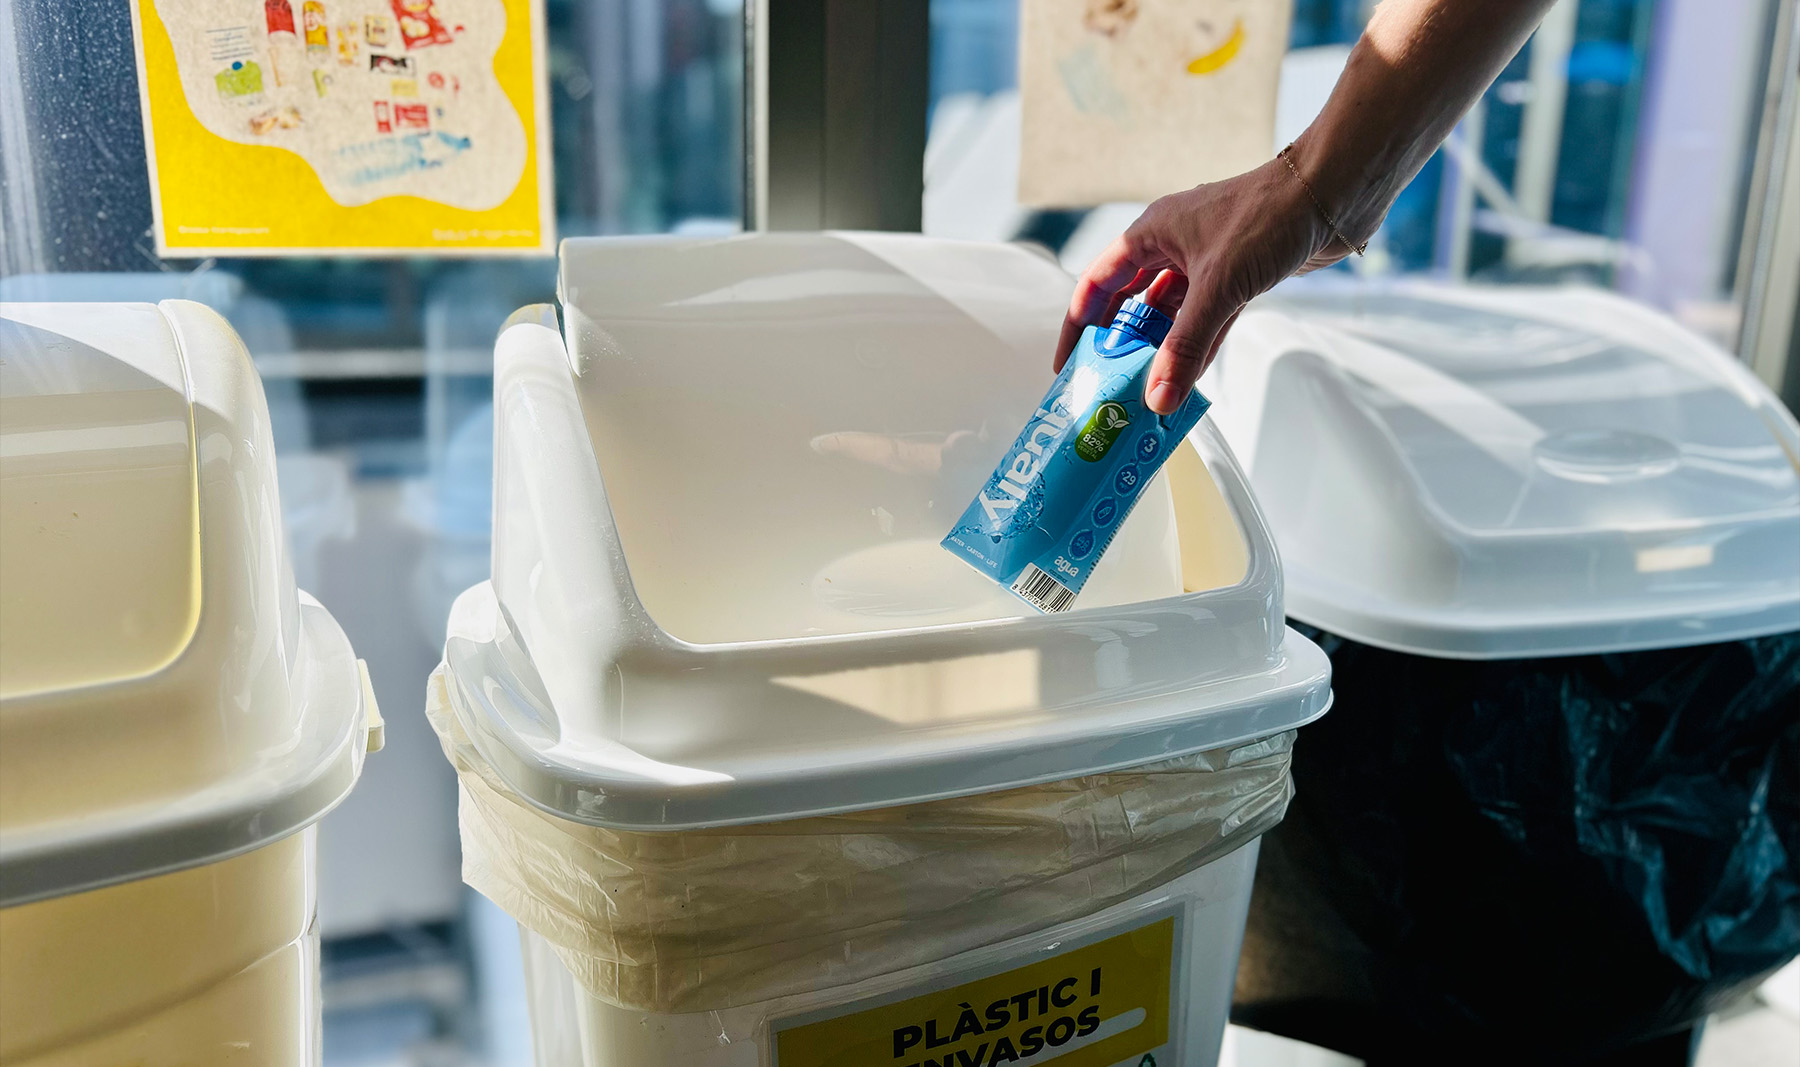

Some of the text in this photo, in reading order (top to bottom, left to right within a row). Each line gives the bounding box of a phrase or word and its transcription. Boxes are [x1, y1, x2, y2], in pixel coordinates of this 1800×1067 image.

[978, 373, 1092, 530] qualy
[1083, 433, 1104, 452] 82%
[986, 558, 998, 568] LIFE
[1054, 555, 1079, 577] agua
[893, 966, 1102, 1059] PLÀSTIC I
[904, 1005, 1100, 1067] VASOS
